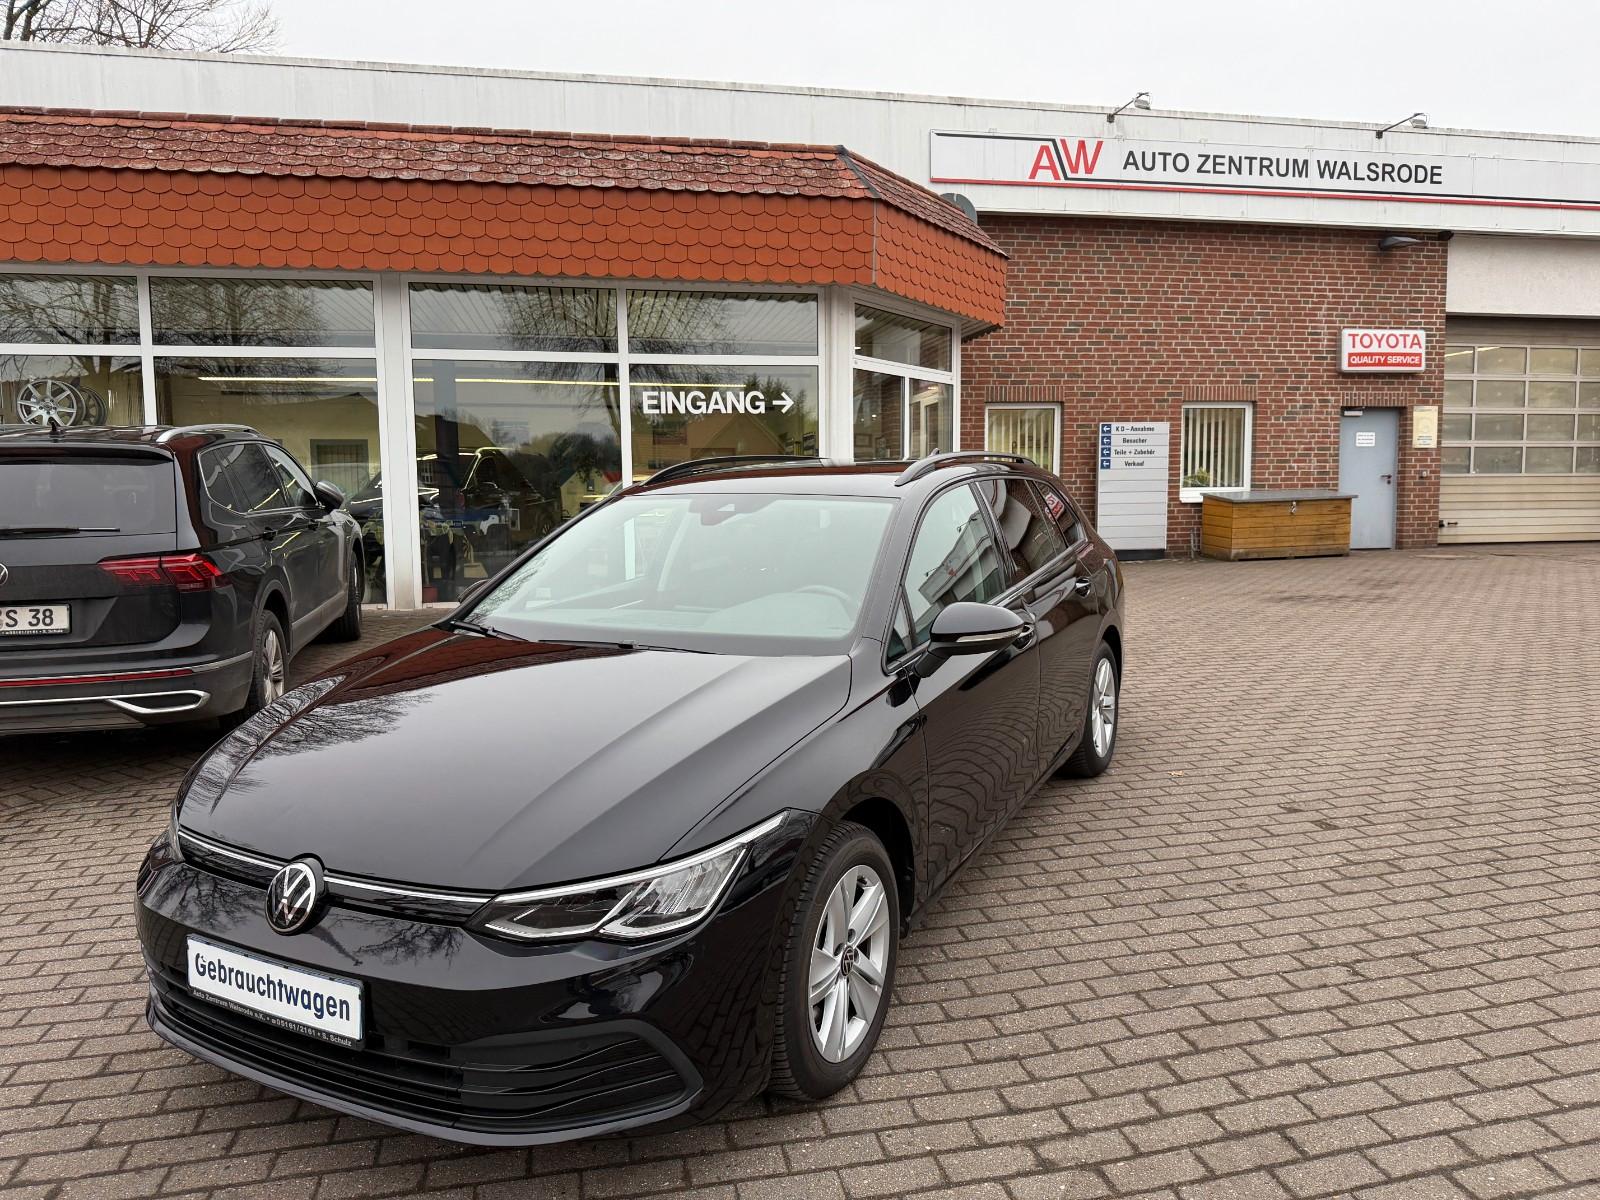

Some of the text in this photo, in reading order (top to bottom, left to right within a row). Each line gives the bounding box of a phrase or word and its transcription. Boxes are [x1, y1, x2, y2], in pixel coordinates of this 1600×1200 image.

[1122, 150, 1443, 185] AUTO ZENTRUM WALSRODE
[1347, 332, 1423, 349] TOYOTA
[1350, 355, 1420, 364] QUALITY SERVICE
[642, 390, 766, 415] EINGANG
[27, 608, 54, 627] 38
[194, 952, 351, 1021] Gebrauchtwagen
[192, 989, 205, 999] Auto
[205, 993, 228, 1007] Zentrum
[329, 1034, 352, 1047] Schulz
